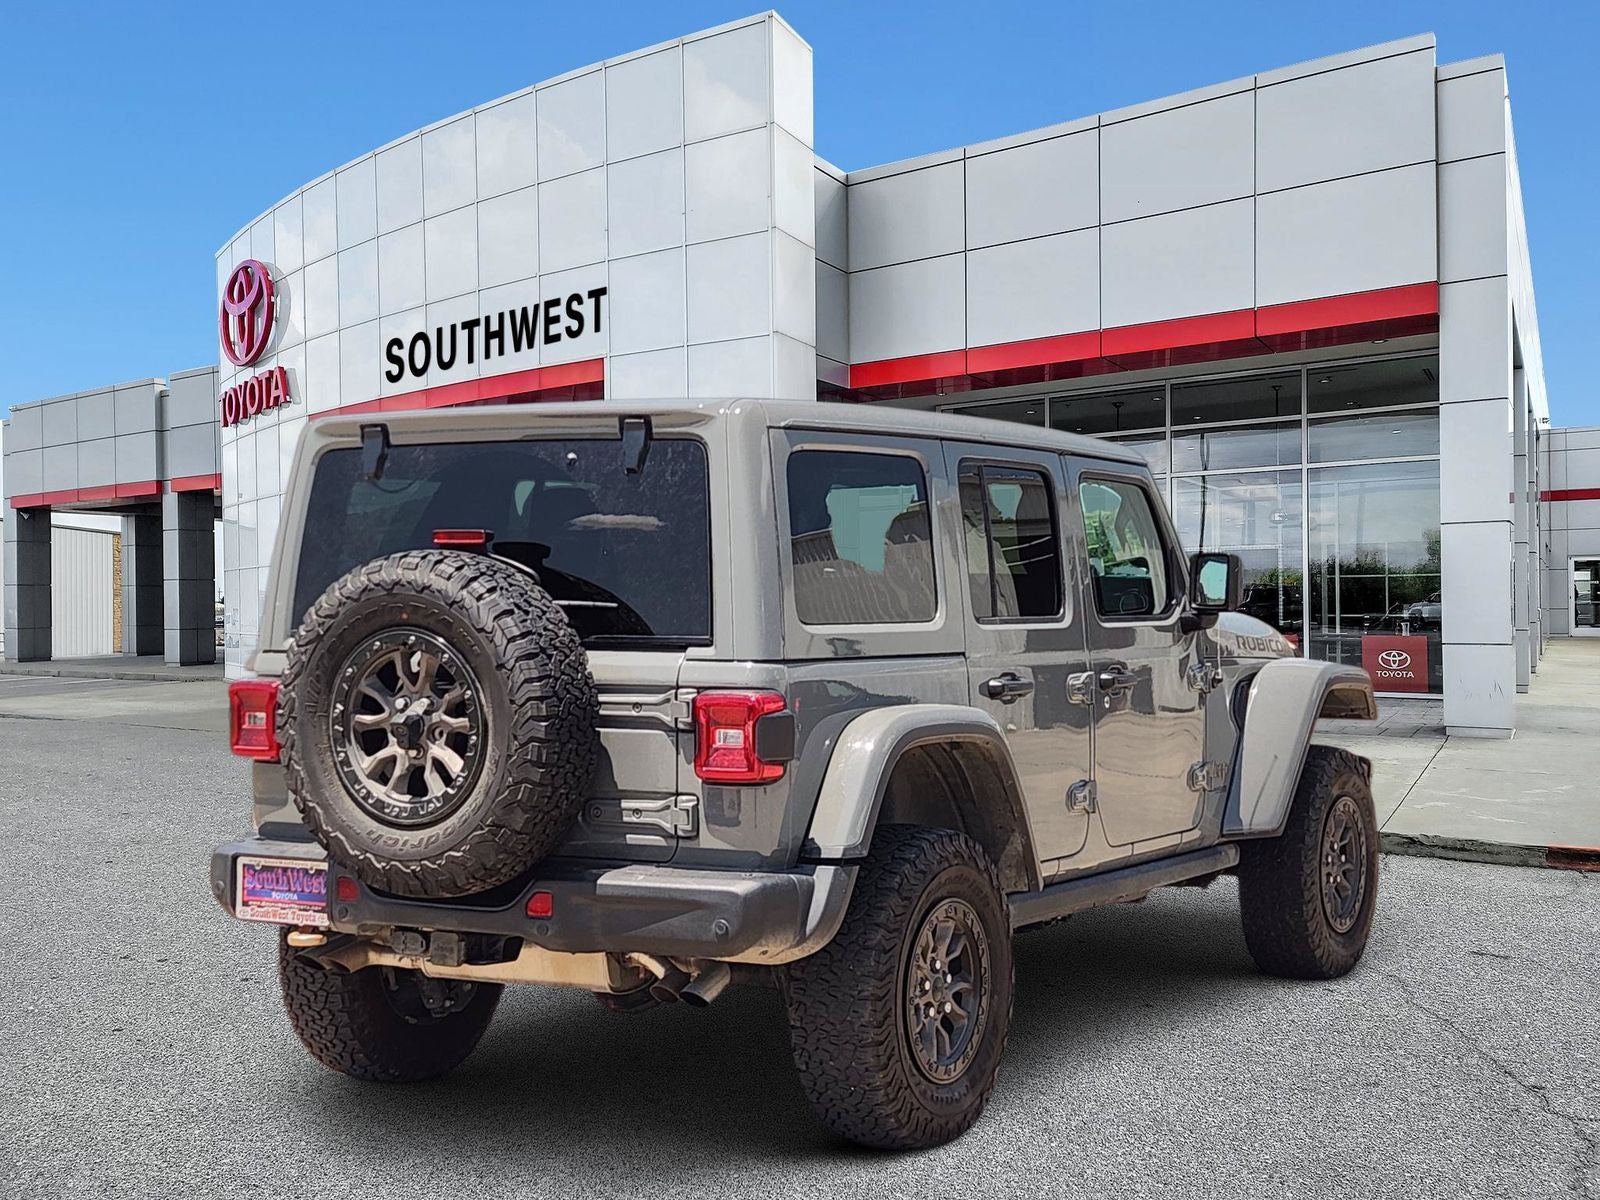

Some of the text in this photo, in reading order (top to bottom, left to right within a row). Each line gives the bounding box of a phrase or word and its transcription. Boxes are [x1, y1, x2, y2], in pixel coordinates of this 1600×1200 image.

[384, 286, 608, 383] SOUTHWEST
[219, 366, 291, 427] TOYOTA
[1235, 635, 1287, 653] RUBICO
[1376, 670, 1414, 678] TOYOTA
[271, 891, 298, 901] TOYOTA
[291, 910, 316, 923] Toyota
